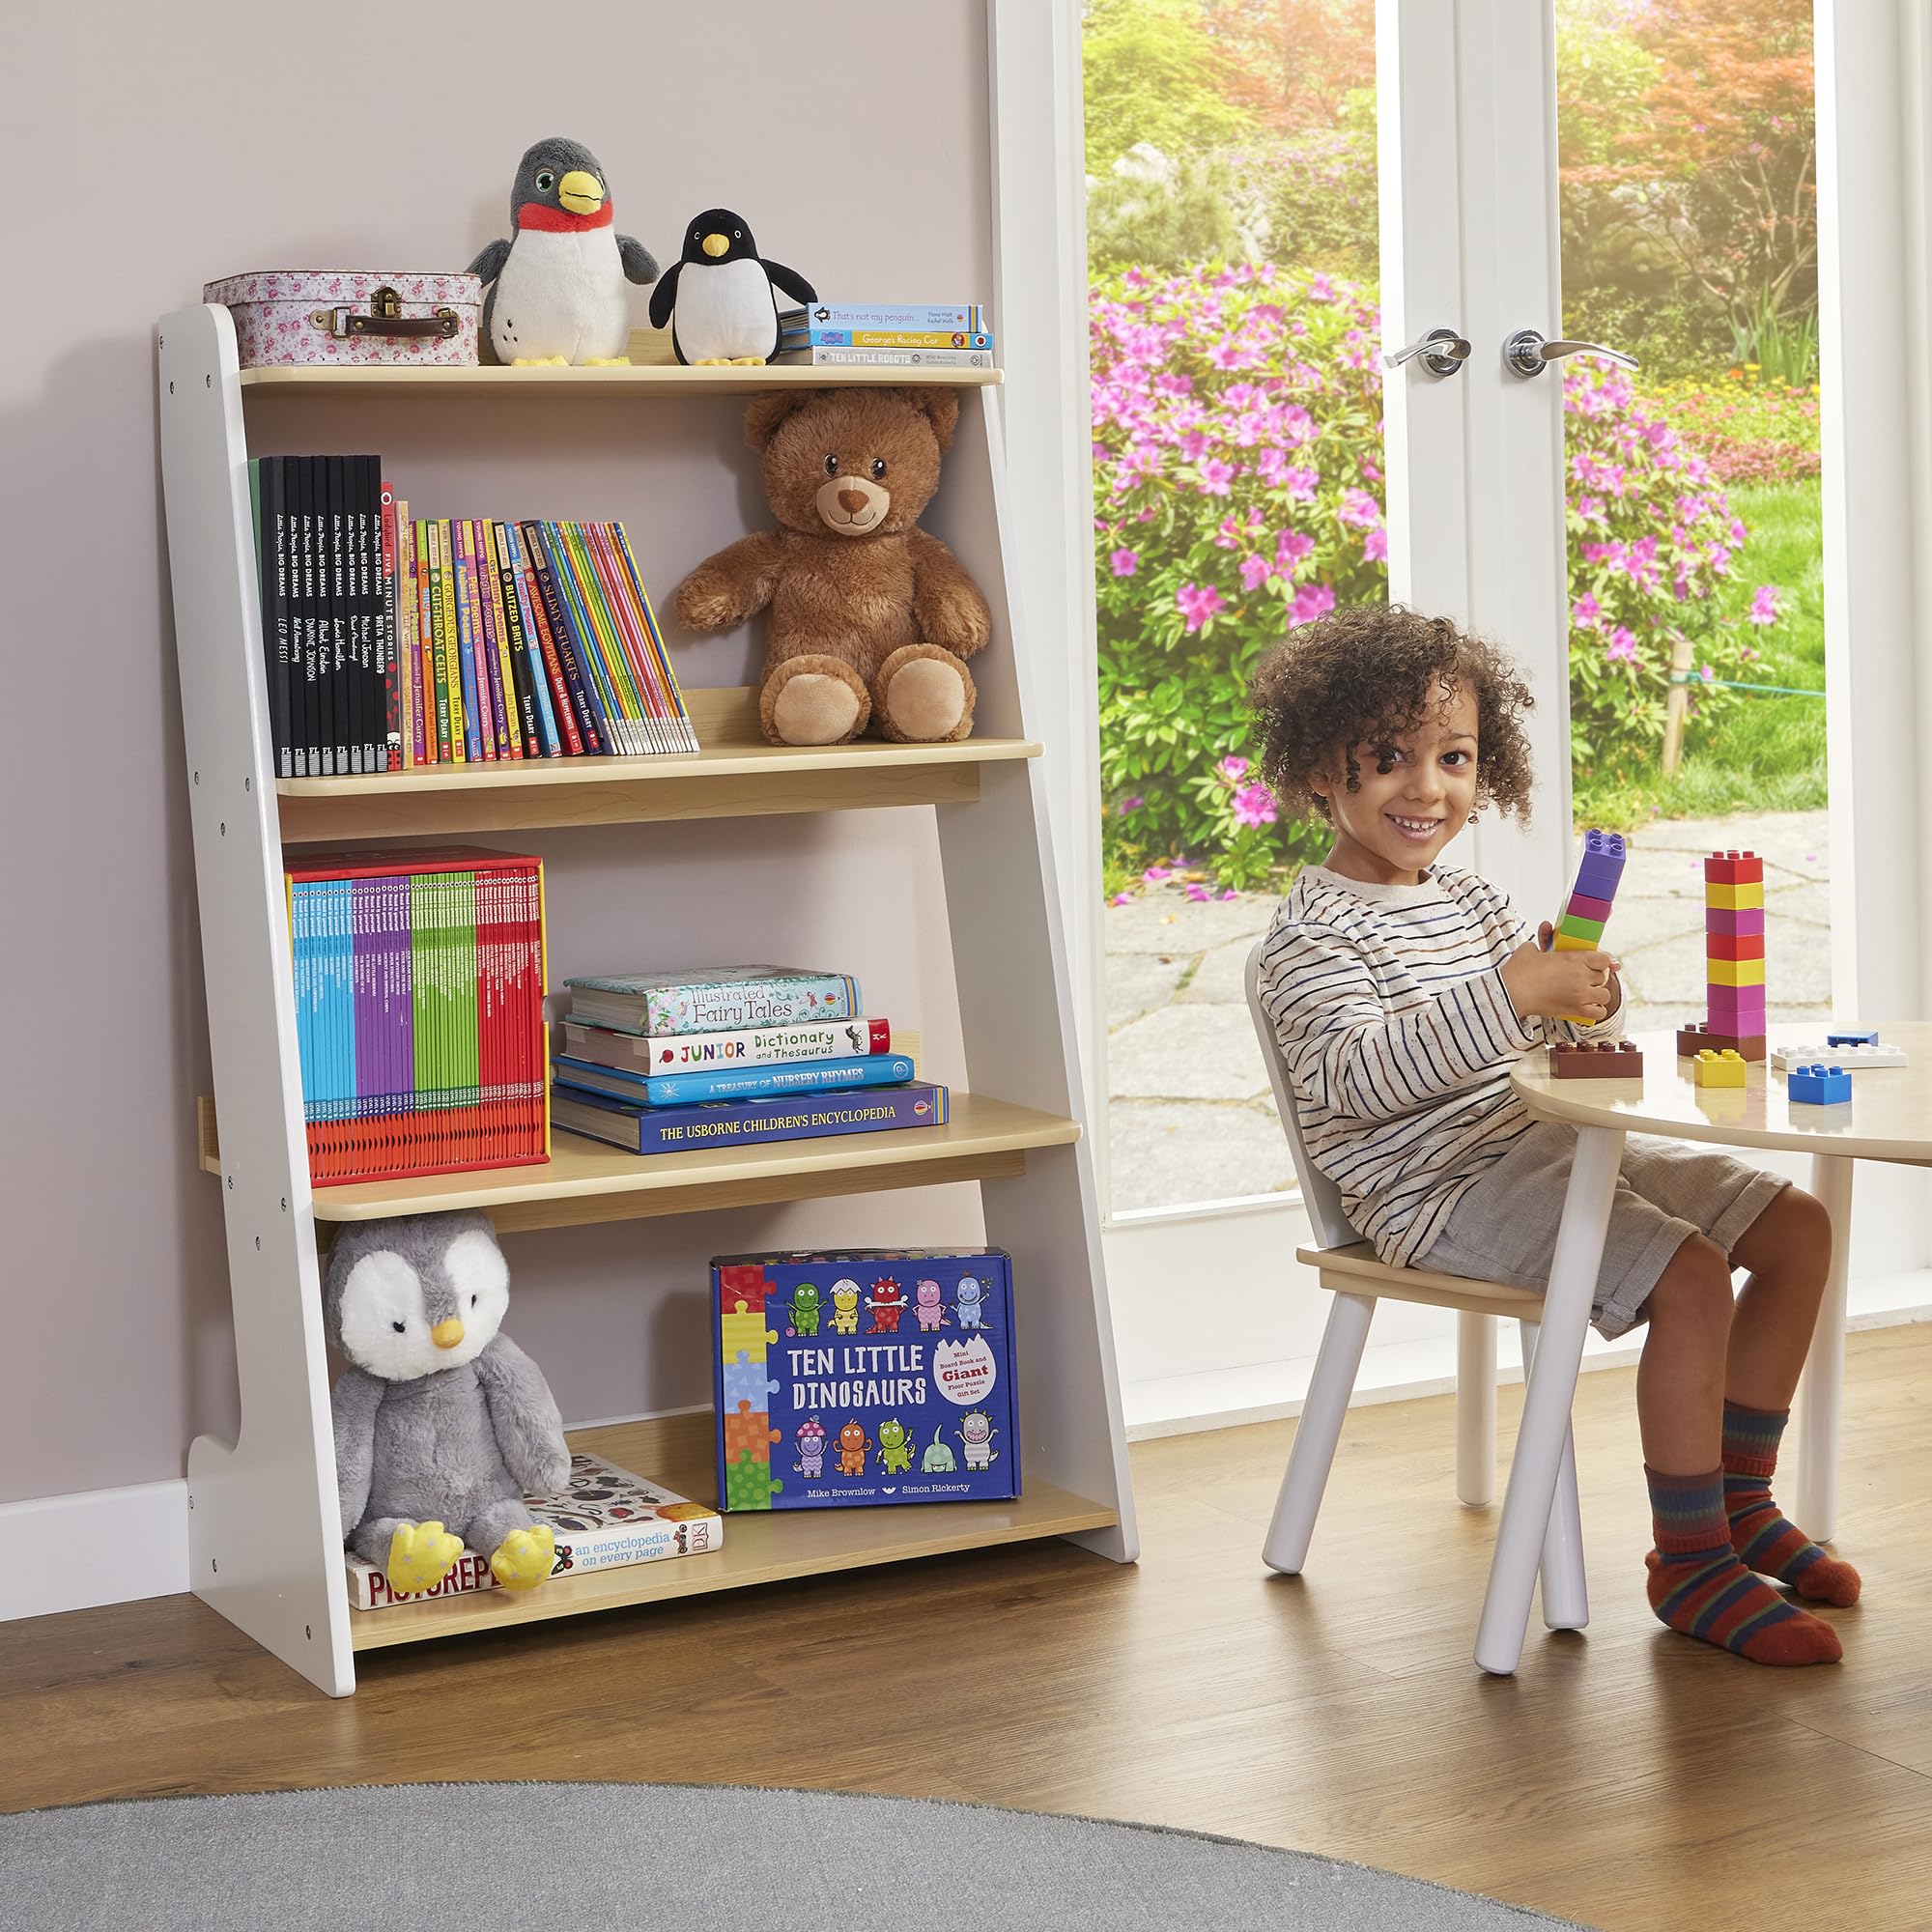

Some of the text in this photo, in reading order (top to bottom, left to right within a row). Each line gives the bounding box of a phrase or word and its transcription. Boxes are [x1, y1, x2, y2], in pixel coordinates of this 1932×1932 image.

[833, 311, 855, 321] That's
[871, 314, 883, 324] my
[863, 333, 938, 347] George's Racing Car
[830, 354, 911, 363] TEN LITTLE ROBOTS
[383, 515, 393, 547] Ladybird
[479, 564, 495, 639] Magic Poems
[491, 574, 502, 605] Funny
[469, 577, 481, 635] Pet Poems
[505, 584, 524, 652] BLITZED BRITS
[278, 618, 288, 663] LEO MESSI
[361, 616, 371, 641] Michael
[432, 586, 446, 683] CUT-THROAT CELTS
[444, 583, 458, 688] GORGEOUS GEORGIANS
[496, 607, 505, 643] Poems
[528, 584, 547, 627] AWESOME
[542, 630, 563, 675] EGYPTIANS
[543, 584, 580, 681] SLIMY STUARTS
[292, 630, 301, 662] Armstrong
[305, 618, 316, 681] DWAYNE JOHNSON
[319, 620, 329, 673] Albert Einstein
[335, 638, 345, 670] Hamilton
[413, 684, 422, 717] Jennifer
[494, 677, 502, 703] Jennifer
[555, 677, 564, 693] DEARY
[523, 696, 534, 734] TERRY DEARY
[576, 690, 592, 728] TERRY DEARY
[414, 719, 424, 744] Curry
[692, 986, 765, 1004] Illustrated
[693, 1000, 792, 1025] Fairy Tales
[681, 1031, 835, 1063] JUNIOR Dictionary
[755, 1045, 834, 1060] and Thesaurus
[709, 1067, 865, 1094] A TREASURY OF NURSERY RHYMES
[660, 1106, 896, 1141] THE USBORNE CHILDREN'S ENCYCLOPEDIA
[787, 1345, 923, 1376] TEN LITTLE
[942, 1365, 989, 1381] Giant
[959, 1358, 974, 1367] Book
[975, 1356, 986, 1365] and
[792, 1378, 926, 1409] DINOSAURS
[948, 1378, 985, 1391] Floor Puzzle
[956, 1387, 980, 1399] Gift Set
[832, 1488, 875, 1496] Brownlow
[902, 1483, 970, 1494] Simon Rickerty
[576, 1531, 670, 1556] an encyclopedia
[693, 1524, 705, 1549] DK
[582, 1546, 665, 1567] on every page
